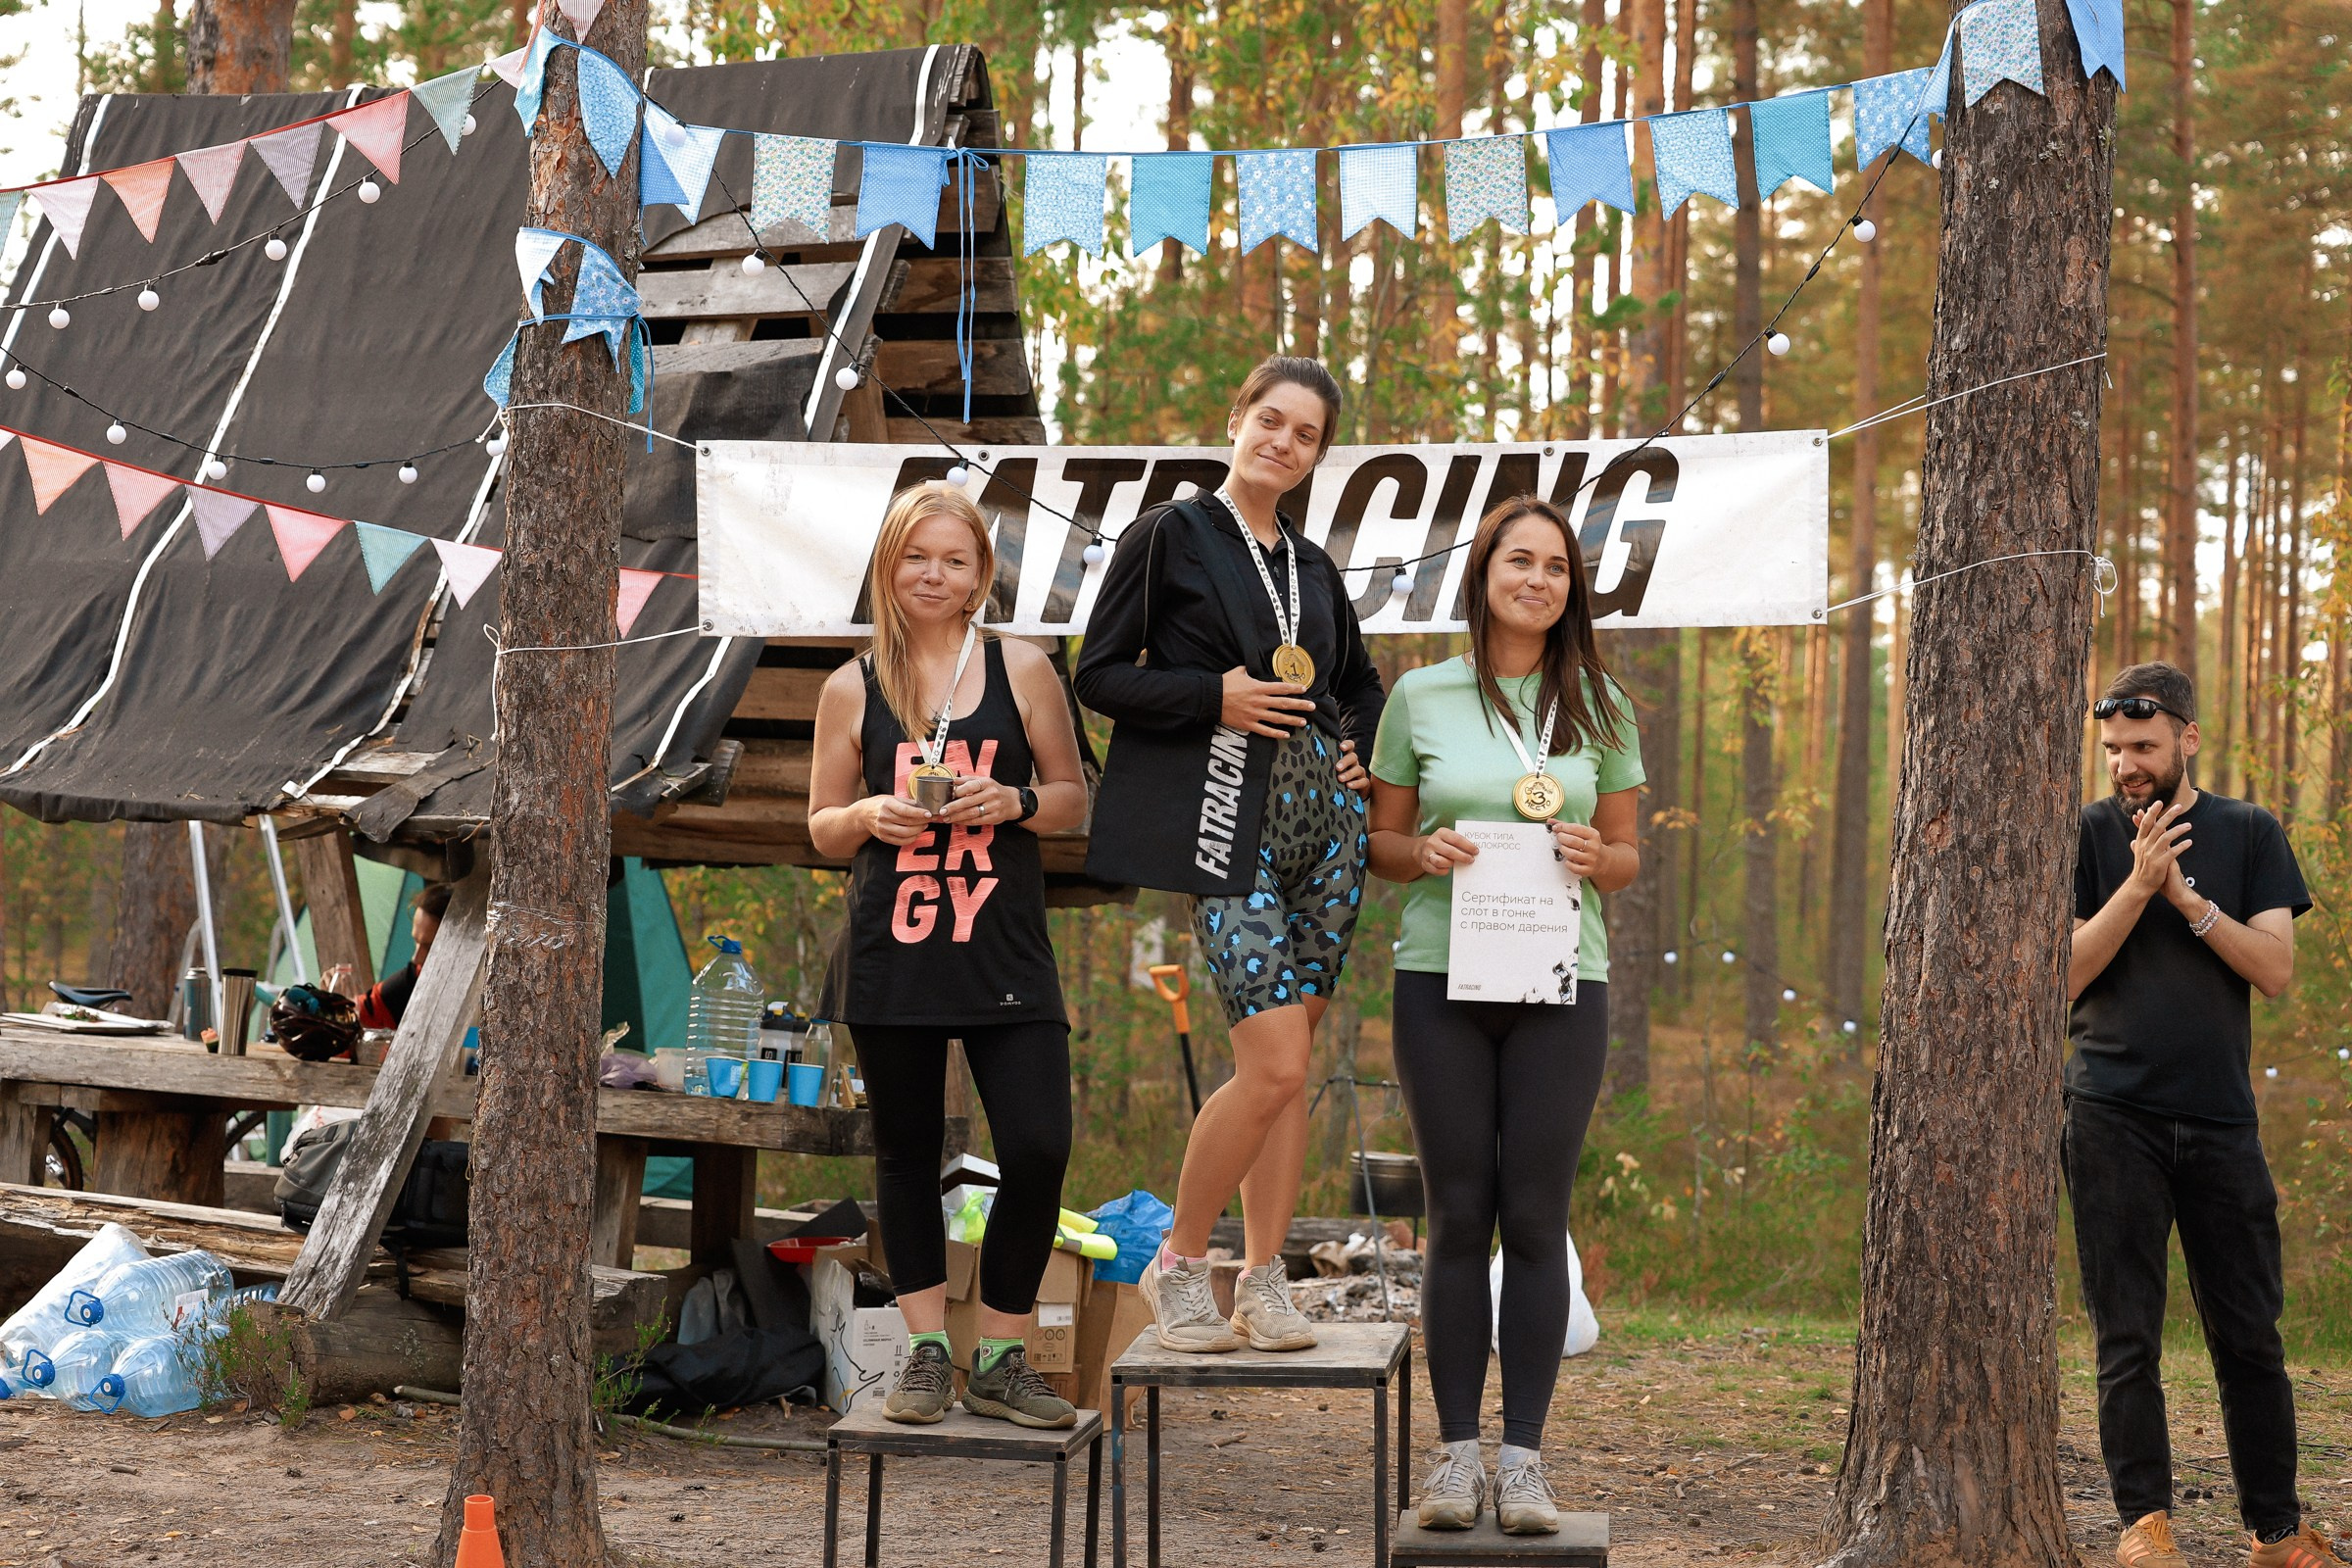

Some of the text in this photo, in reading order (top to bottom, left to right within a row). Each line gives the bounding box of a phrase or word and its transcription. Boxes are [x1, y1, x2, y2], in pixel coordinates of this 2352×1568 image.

[851, 447, 1680, 624] ATCIG
[1195, 722, 1250, 879] FATRACIN
[1531, 791, 1545, 805] 3
[1464, 831, 1491, 840] КУБОК
[1473, 841, 1521, 850] КЛОКРОСС
[1461, 891, 1553, 906] Сертификат на
[892, 875, 999, 944] GY
[1460, 907, 1537, 918] слот в гонке
[1460, 920, 1568, 935] с правом дарения
